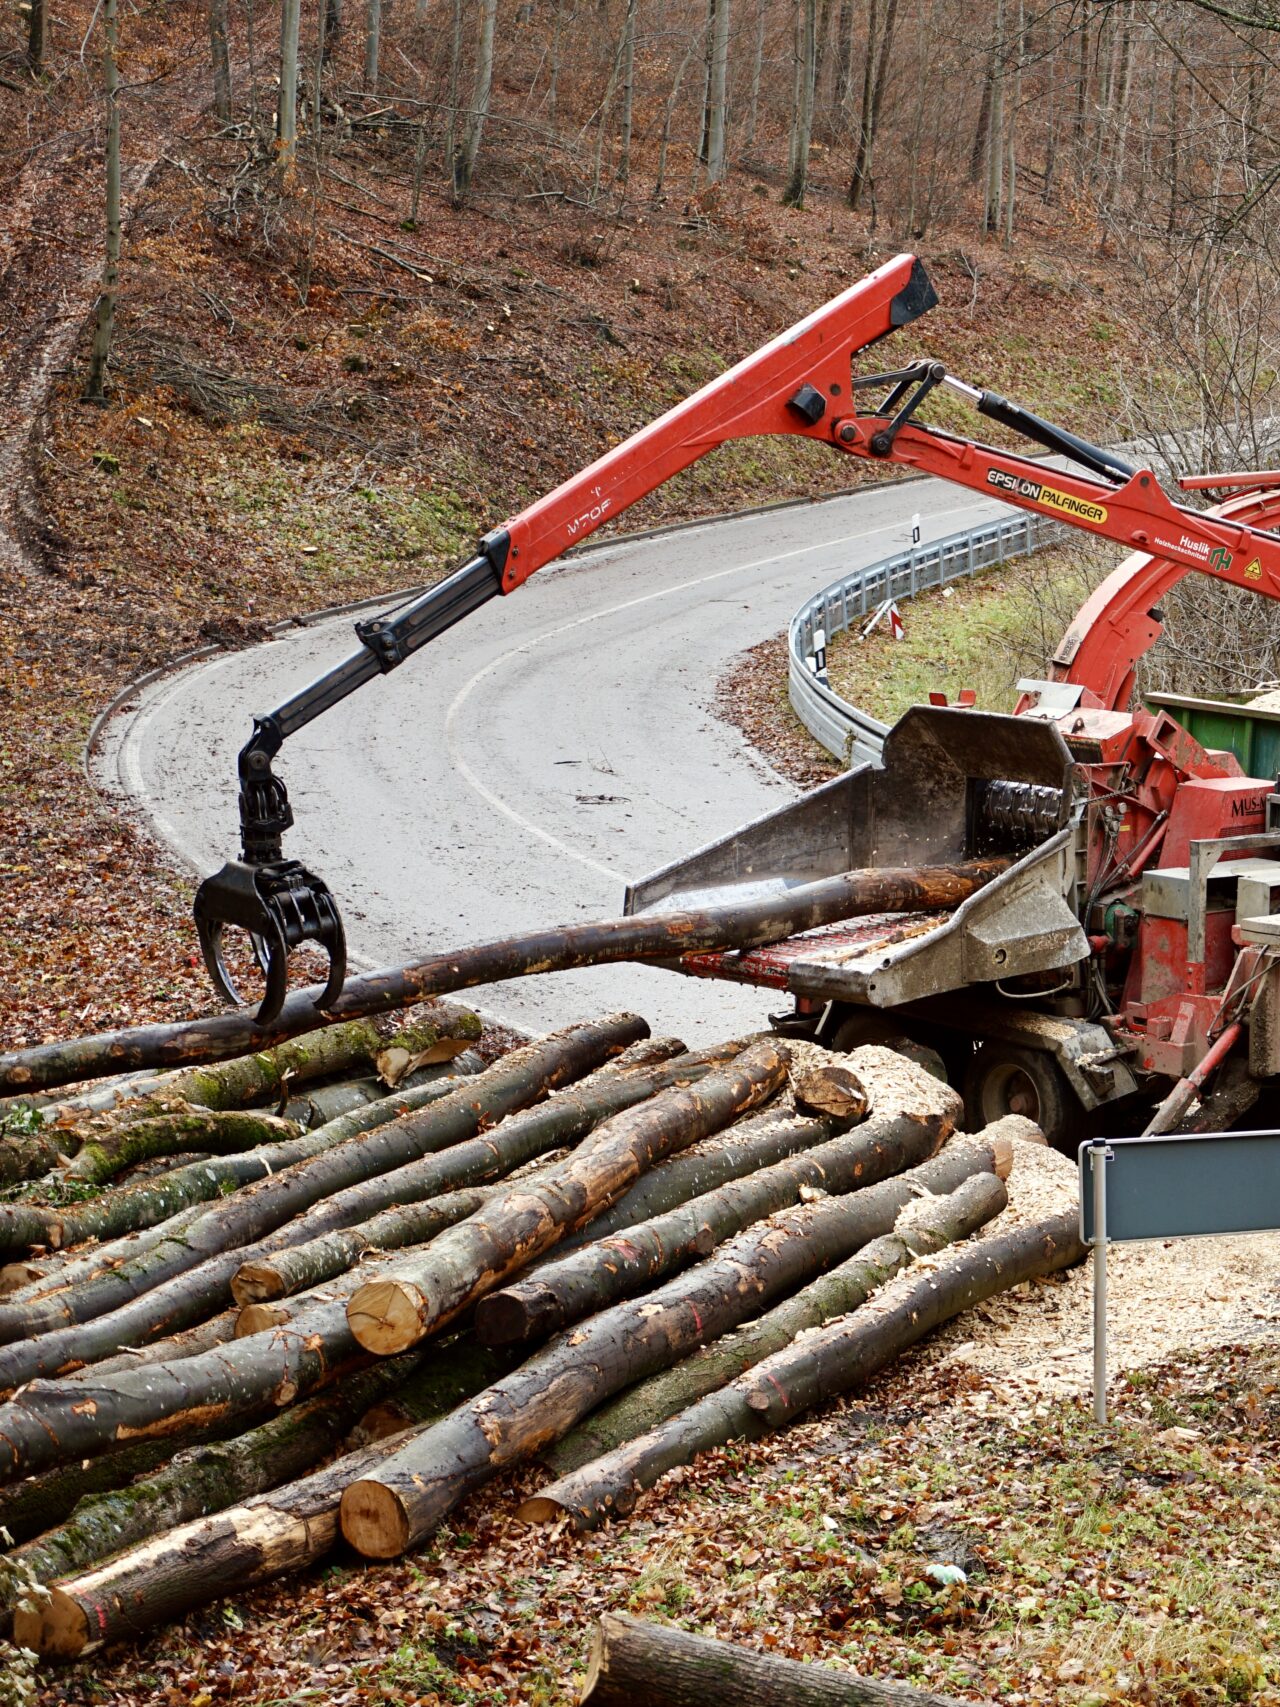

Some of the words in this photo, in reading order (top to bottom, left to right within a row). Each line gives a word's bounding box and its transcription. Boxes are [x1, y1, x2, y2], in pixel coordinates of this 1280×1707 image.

[987, 470, 1040, 499] EPSION
[1041, 490, 1103, 521] PALFINGER
[1180, 535, 1210, 555] Huslik
